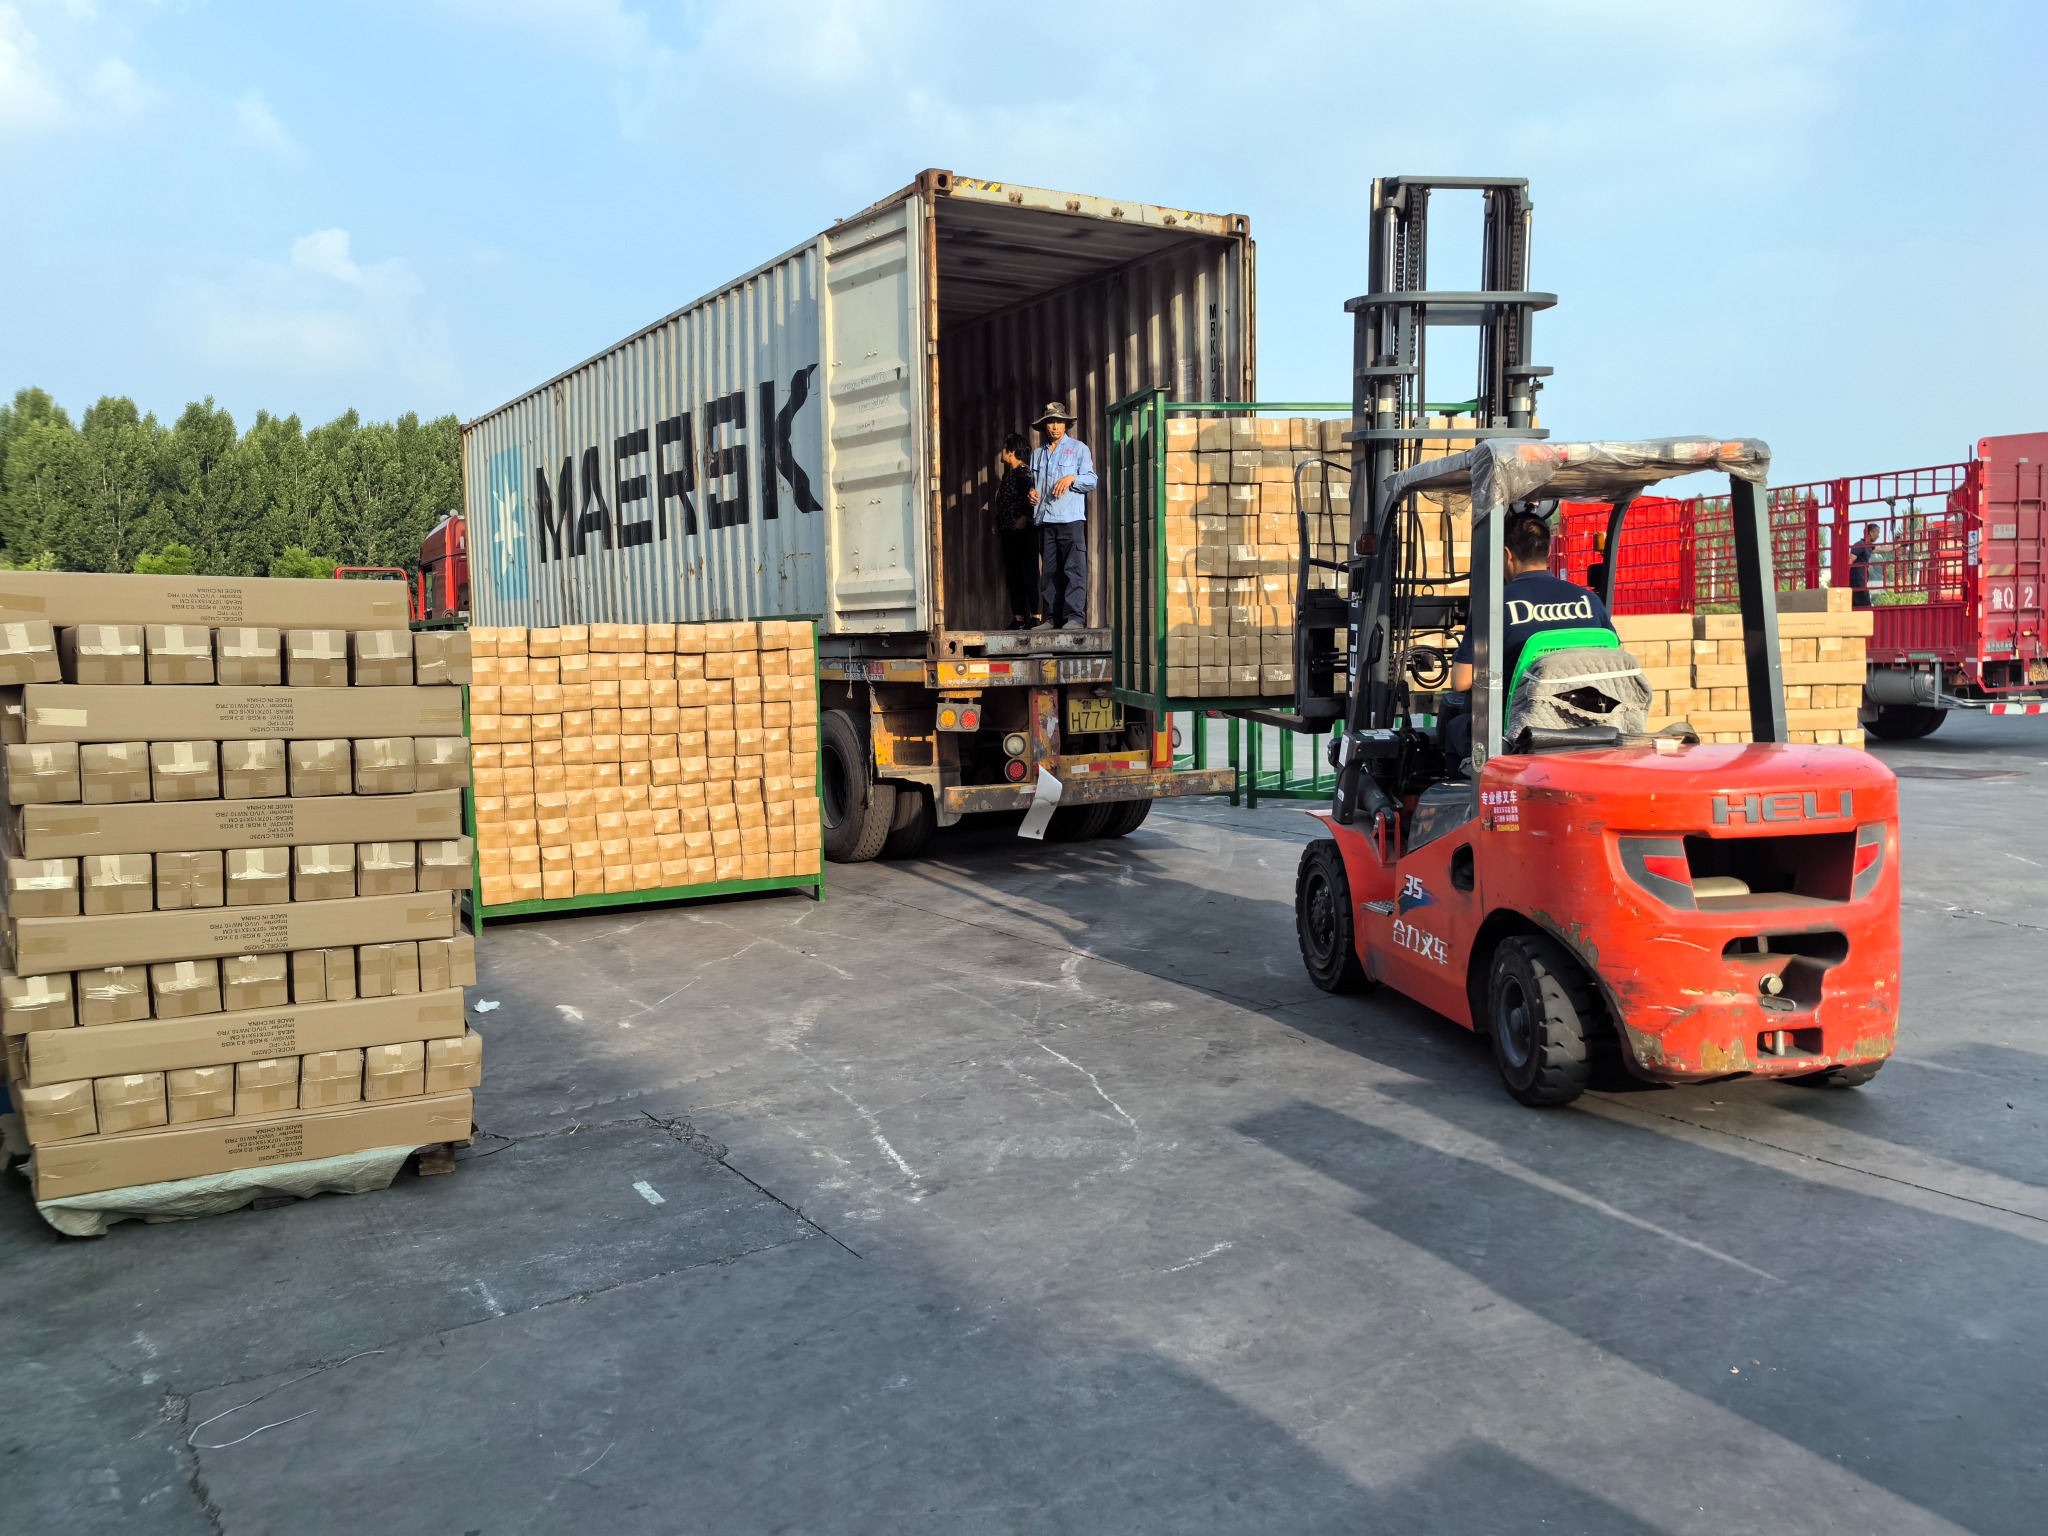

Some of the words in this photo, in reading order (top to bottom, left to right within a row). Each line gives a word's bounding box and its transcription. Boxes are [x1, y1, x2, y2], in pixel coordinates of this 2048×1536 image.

[1209, 303, 1217, 373] MRKU
[536, 363, 824, 563] MAERSK
[1712, 790, 1853, 824] HELI
[1403, 873, 1423, 900] 35
[1393, 919, 1448, 965] 合力叉车
